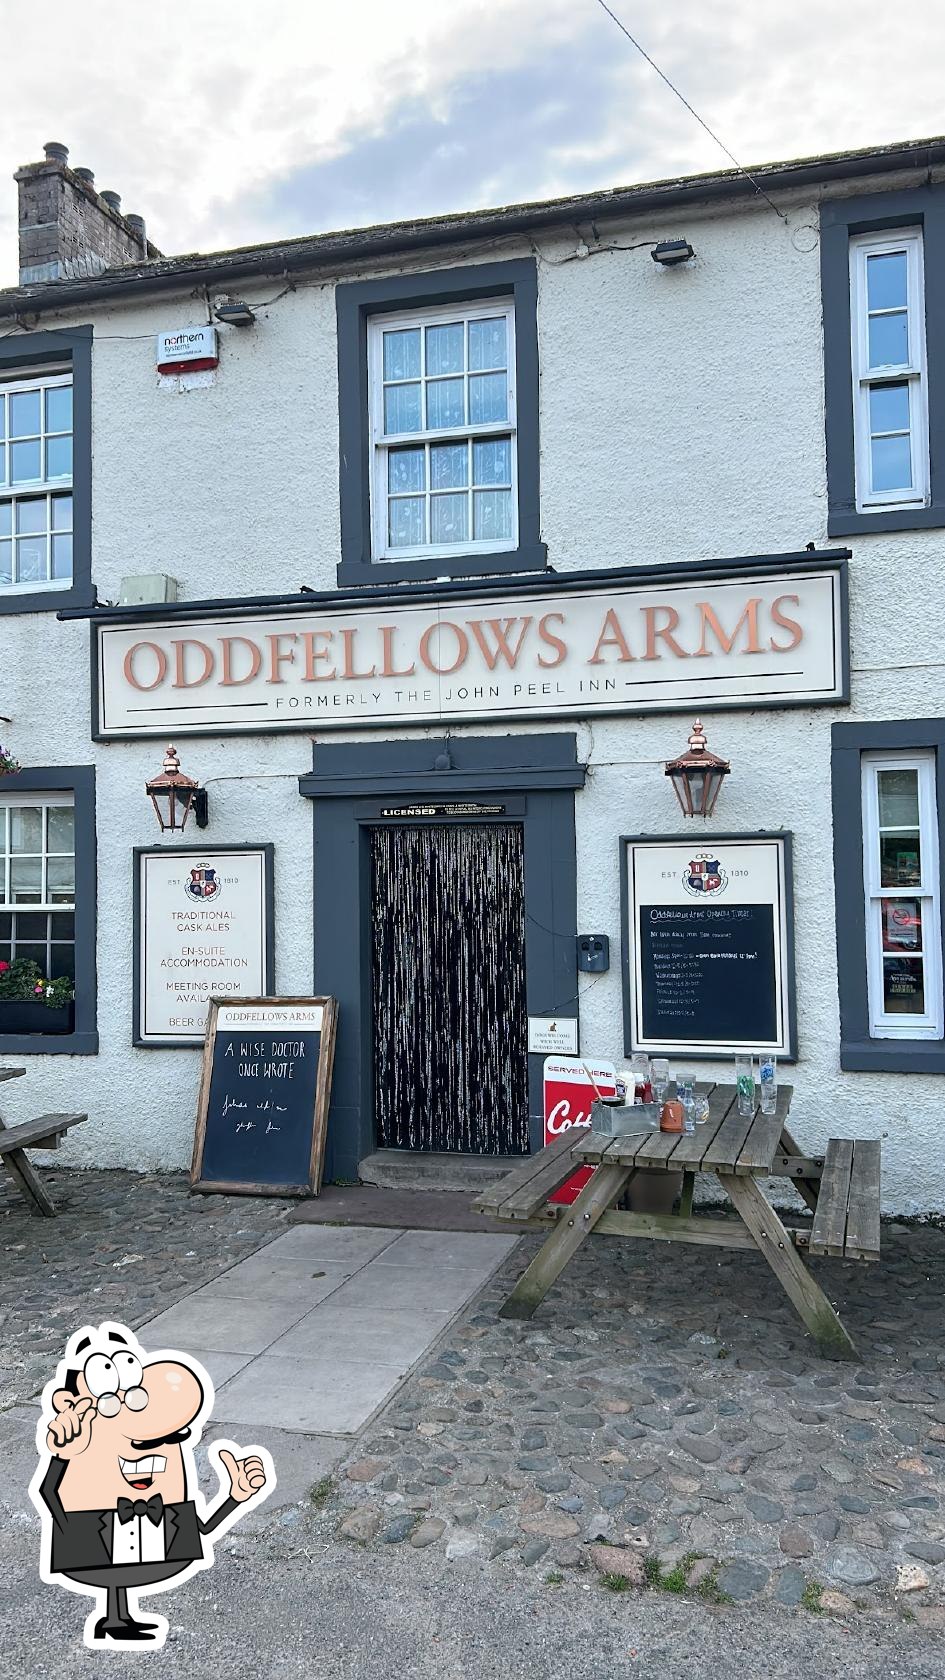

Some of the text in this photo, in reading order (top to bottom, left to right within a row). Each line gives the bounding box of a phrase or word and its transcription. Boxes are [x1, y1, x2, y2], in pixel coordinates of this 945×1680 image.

[164, 333, 204, 345] northern
[164, 344, 190, 353] systems
[123, 594, 804, 692] ODDFELLOWS ARMS
[276, 678, 617, 709] FORMERLY THE JOHN PEEL INN
[383, 808, 436, 816] LICENSED
[171, 911, 236, 921] TRADITIONAL
[176, 923, 230, 932] CASK ALES
[181, 946, 225, 956] EN-SUITE
[160, 958, 248, 968] ACCOMMODATION
[166, 982, 241, 991] MEETING ROOM
[176, 994, 231, 1003] AVAILA
[169, 1017, 195, 1026] BEER
[225, 1012, 315, 1022] ODDFELLOWS ARMS
[224, 1041, 305, 1058] A WISE DOCTOR
[238, 1062, 295, 1079] ONCE WROTE
[547, 1065, 585, 1075] SERVED
